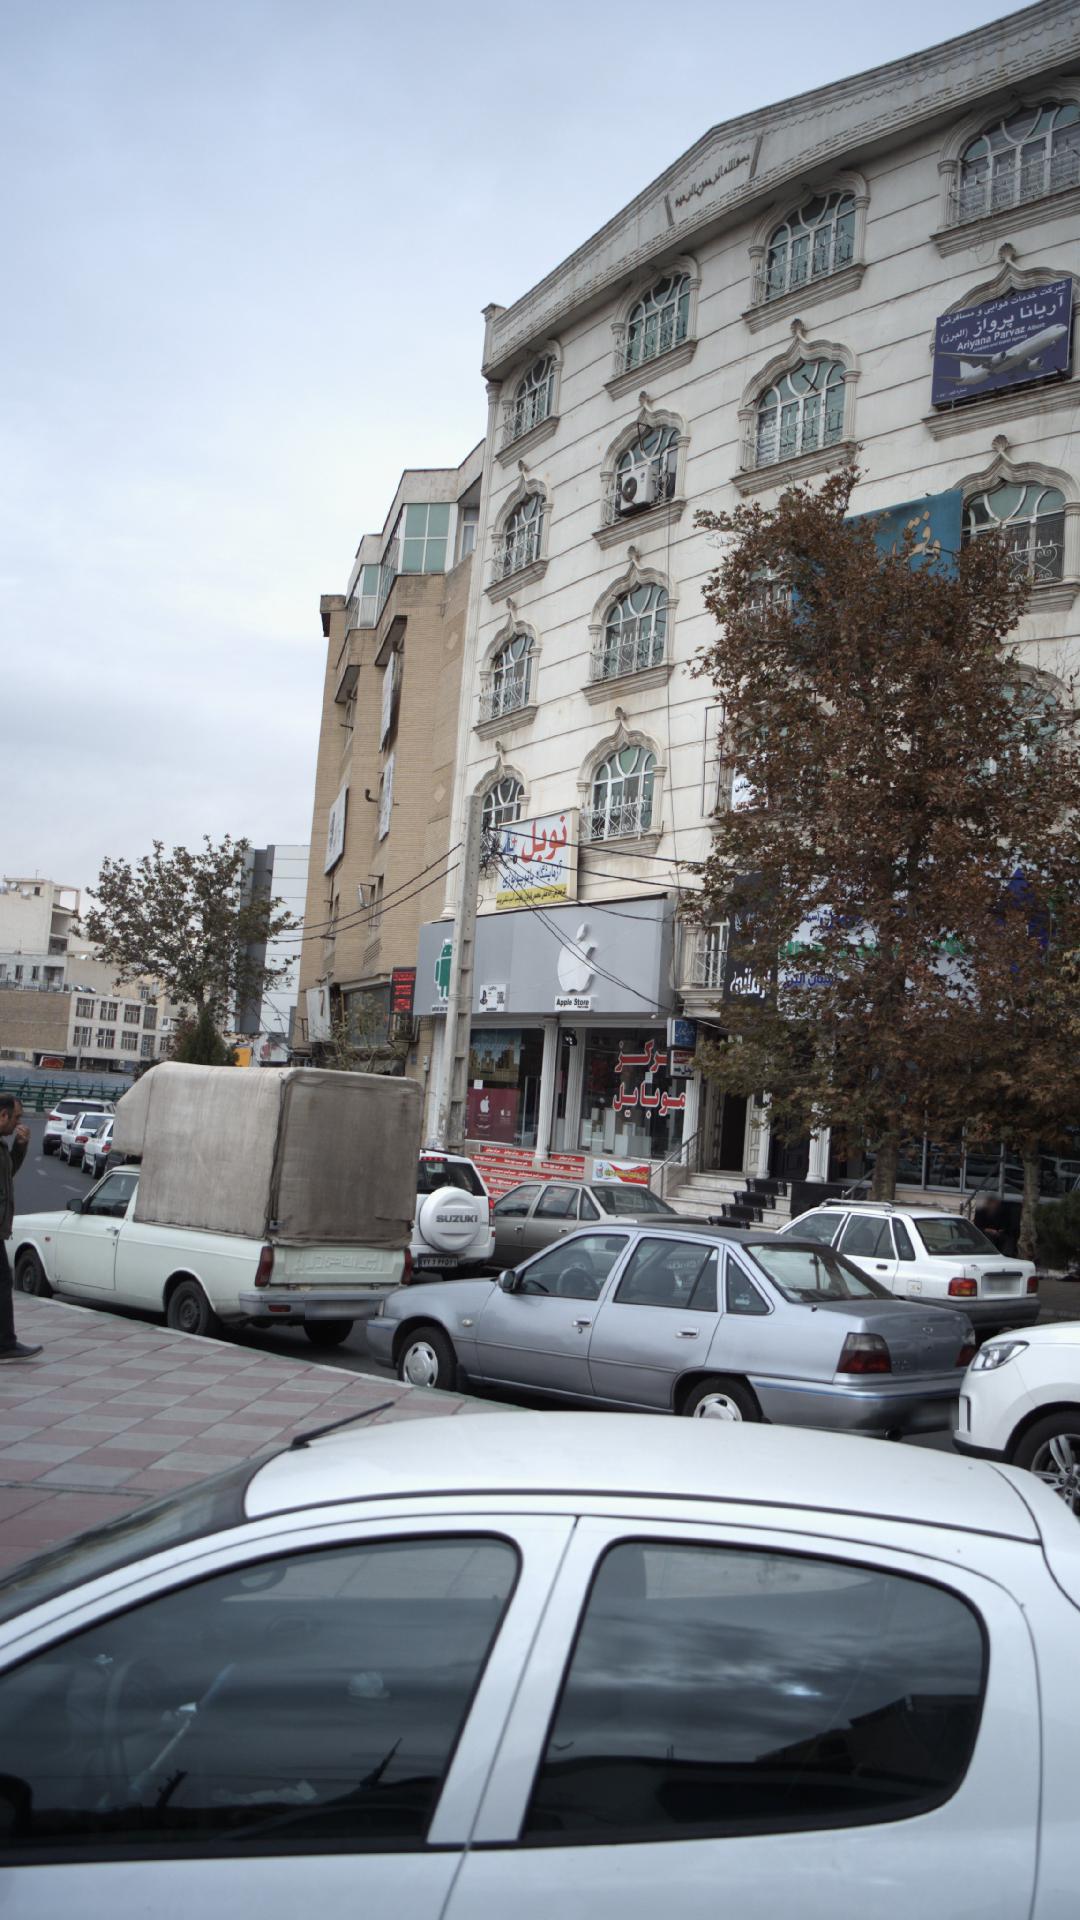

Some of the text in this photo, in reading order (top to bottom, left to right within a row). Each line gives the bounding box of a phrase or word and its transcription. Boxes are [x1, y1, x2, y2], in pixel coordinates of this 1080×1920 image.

[1011, 292, 1037, 305] خدمات
[1040, 282, 1067, 296] شرکت
[1020, 293, 1064, 319] آریانا
[973, 315, 1015, 338] پرواز
[957, 336, 992, 352] Ariyana
[994, 327, 1025, 341] Parvaz
[521, 815, 567, 864] نوبل
[556, 998, 573, 1008] Apple
[574, 998, 590, 1006] Store
[615, 1040, 667, 1073] رکز
[613, 1081, 686, 1119] موبایل
[436, 1214, 479, 1223] SUZUKI
